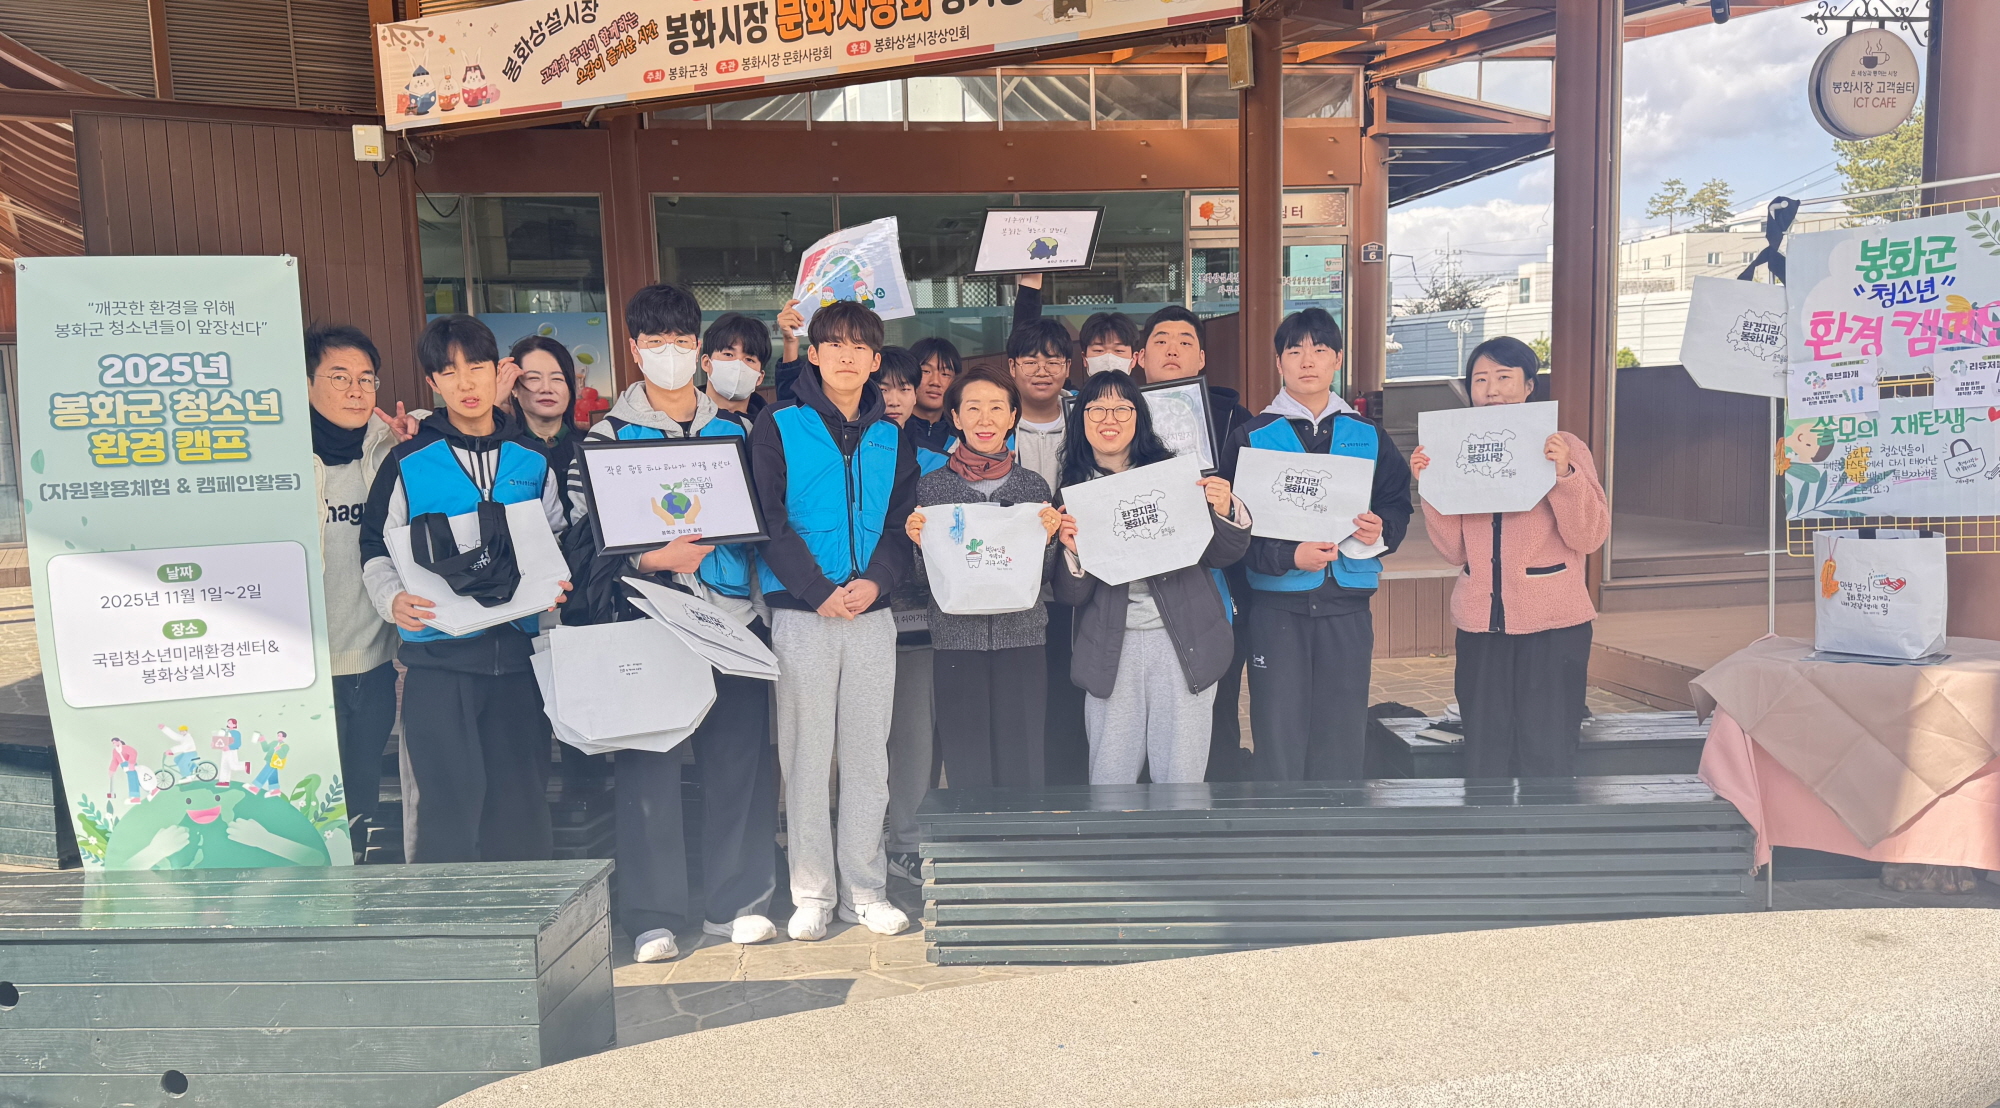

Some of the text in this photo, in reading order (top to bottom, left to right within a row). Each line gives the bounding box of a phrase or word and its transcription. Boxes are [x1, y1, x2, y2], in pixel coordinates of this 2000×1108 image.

[666, 1, 768, 55] 봉화시장
[502, 0, 599, 83] 봉화상설시장
[540, 11, 639, 85] 고객과 주민이 함께하는
[576, 19, 660, 86] 오감이 즐거운 시간
[646, 25, 970, 82] 주최 봉화군청 주관 봉화시장 문화사랑회 후원 봉화상설시장상인회
[1832, 81, 1915, 94] 봉화시장 고객쉼터
[1853, 97, 1897, 108] ICT CAFE
[1369, 252, 1376, 260] 6
[1855, 235, 1958, 283] 봉화군
[149, 299, 198, 316] 환경을
[202, 299, 235, 316] 위해
[54, 321, 104, 338] 봉화군
[108, 319, 191, 336] 청소년들이
[1742, 320, 1782, 336] 환경지킴
[1804, 310, 1884, 361] 환경
[1740, 331, 1779, 346] 봉화사랑
[100, 353, 231, 386] 2025년
[52, 390, 282, 428] 봉화군 청소년
[1810, 415, 1878, 443] 쓸모의
[90, 429, 249, 465] 환경 캠프
[1467, 442, 1503, 453] 환경지킴
[1844, 443, 1925, 460] 봉화군 청소년들이
[1467, 452, 1503, 464] 봉화사랑
[1889, 458, 1906, 467] 다시
[1909, 455, 1938, 466] 태어난
[176, 477, 191, 493] &
[1284, 474, 1320, 487] 환경지킴
[1283, 484, 1319, 497] 봉화사랑
[325, 499, 367, 525] hag
[1121, 503, 1157, 521] 환경지킴
[1124, 513, 1159, 530] 봉화사랑
[165, 565, 193, 581] 날짜
[100, 583, 262, 609] 2025년 11월 1일~2일
[171, 622, 199, 637] 장소
[92, 639, 279, 668] 국립청소년미래환경센터&
[141, 661, 236, 685] 봉화상설시장
